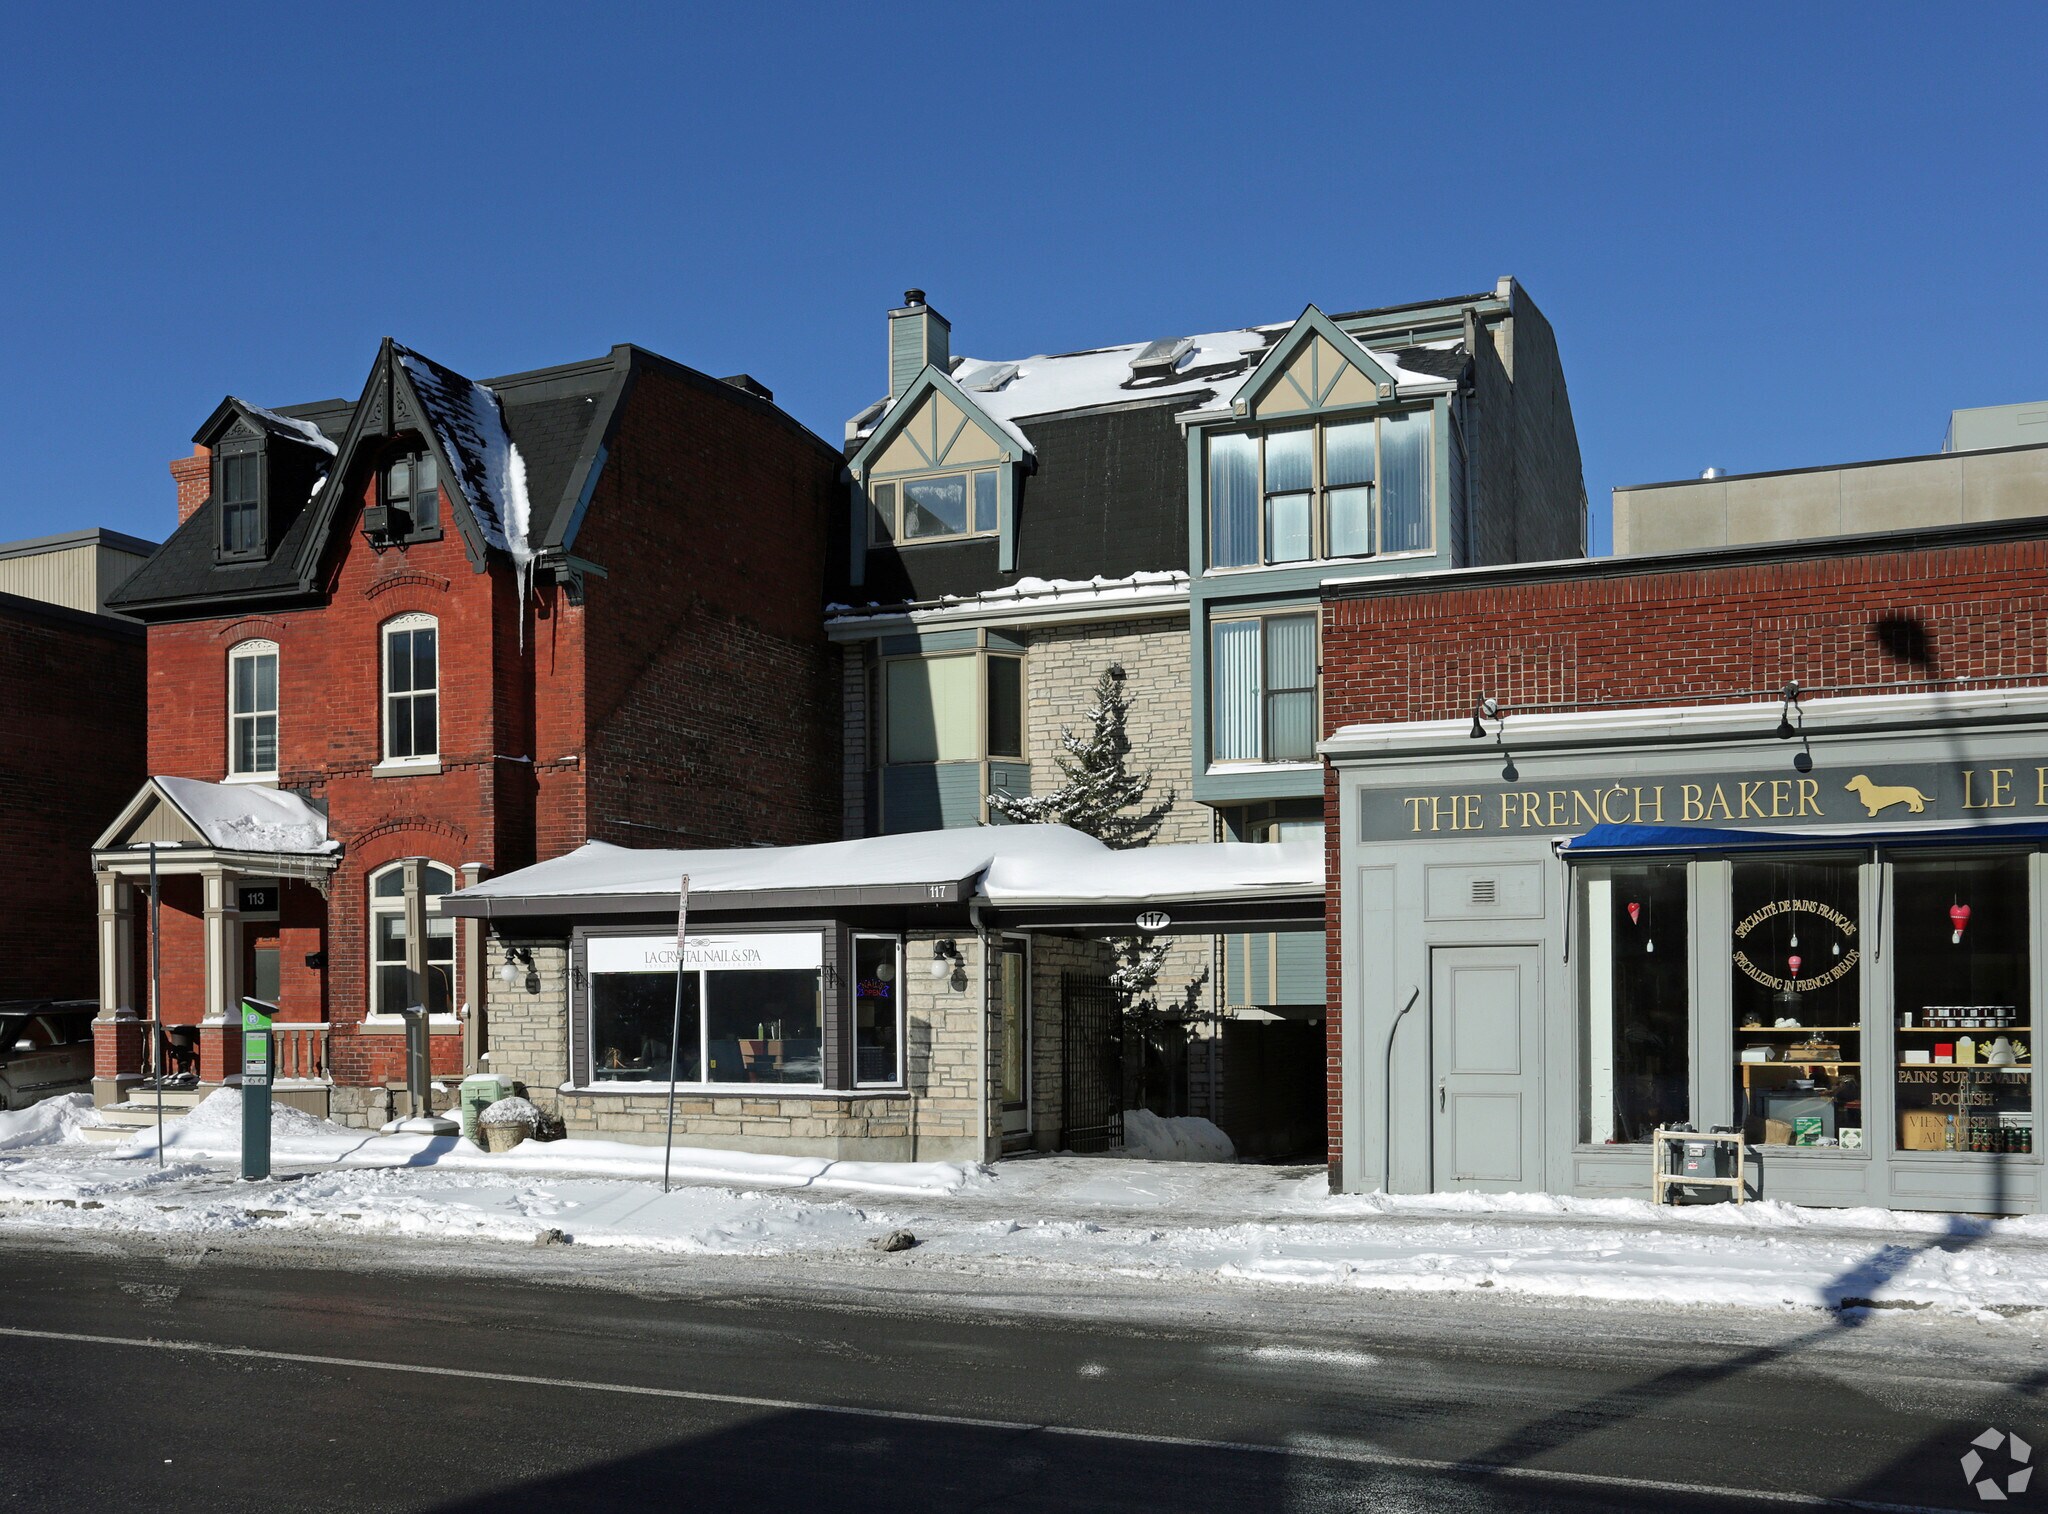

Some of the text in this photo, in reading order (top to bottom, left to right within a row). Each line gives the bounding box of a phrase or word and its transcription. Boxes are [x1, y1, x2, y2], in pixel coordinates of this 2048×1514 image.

[1961, 767, 2016, 809] LE
[1404, 778, 1825, 832] THE FRENCH BAKER
[247, 892, 265, 905] 113
[929, 885, 946, 898] 117
[1140, 912, 1163, 926] 117
[1734, 899, 1857, 939] SPÉCIALITÉ DE PAINS FRANÇAIS
[645, 949, 762, 964] LA CRYTAL NAIL & SPA
[1733, 949, 1860, 992] SPECIALIZING IN FRENCH BREADS
[1898, 1070, 2028, 1084] PAINS SUR LEVAIN
[1931, 1092, 1994, 1106] POOLISH
